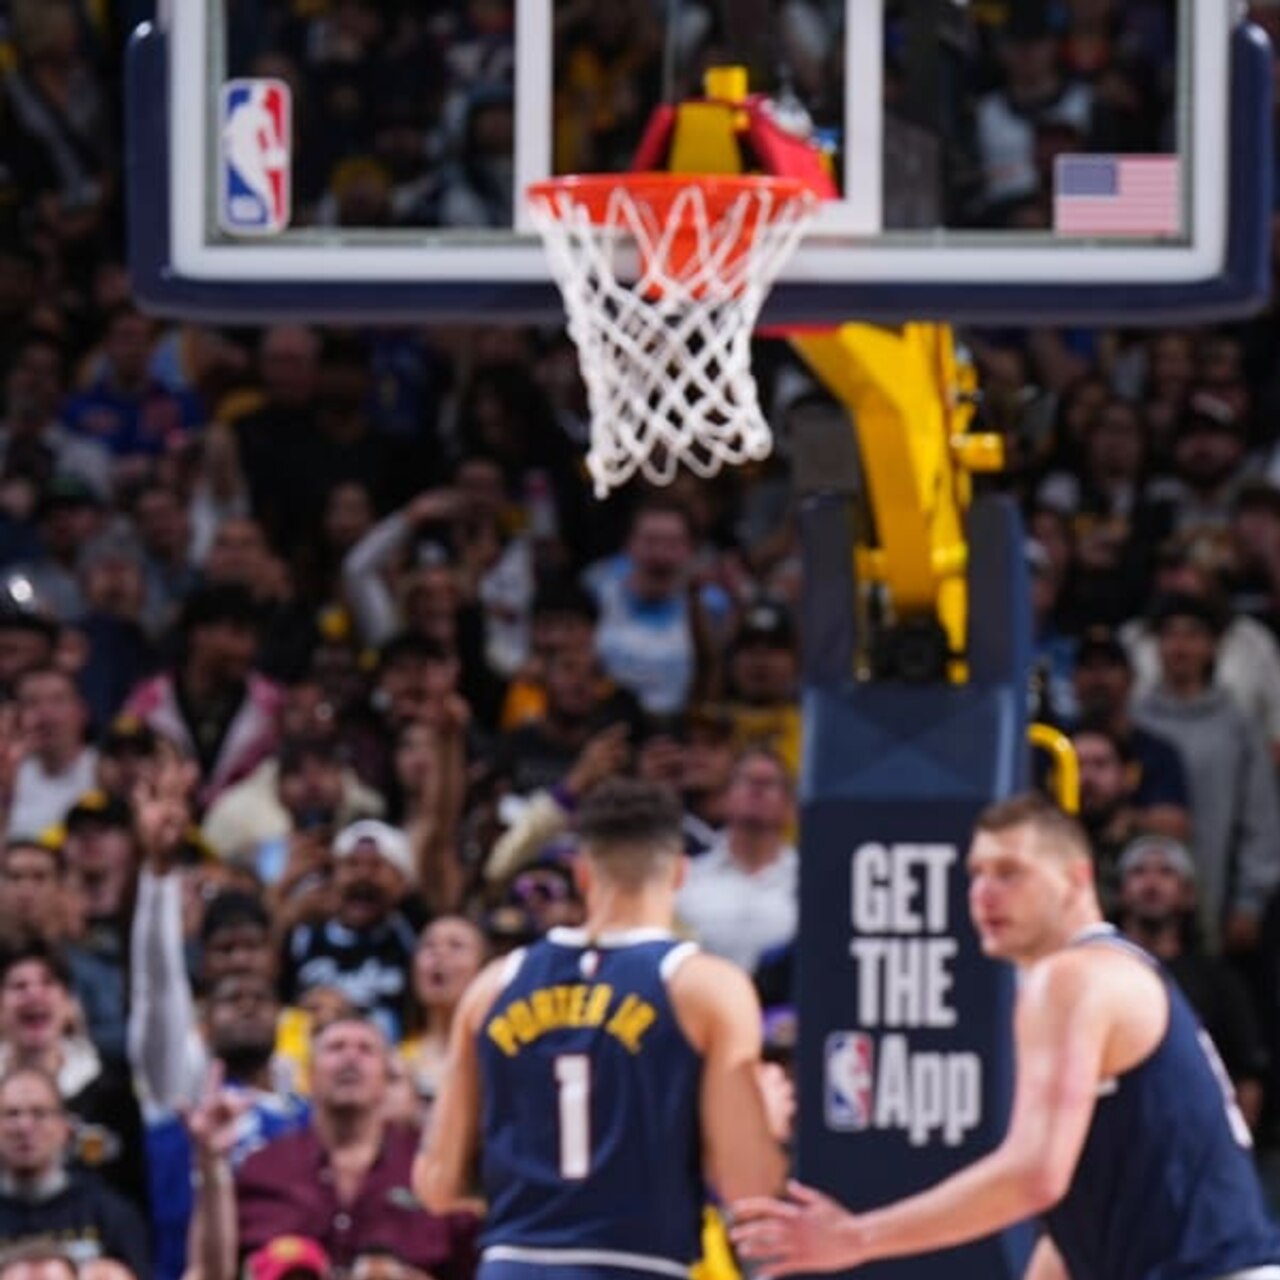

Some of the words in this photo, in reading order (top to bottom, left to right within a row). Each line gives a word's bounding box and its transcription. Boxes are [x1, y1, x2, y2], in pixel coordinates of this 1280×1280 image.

[851, 842, 956, 933] GET
[487, 982, 614, 1058] PORTER
[851, 937, 957, 1027] THE
[554, 1053, 591, 1180] 1
[877, 1037, 980, 1145] App
